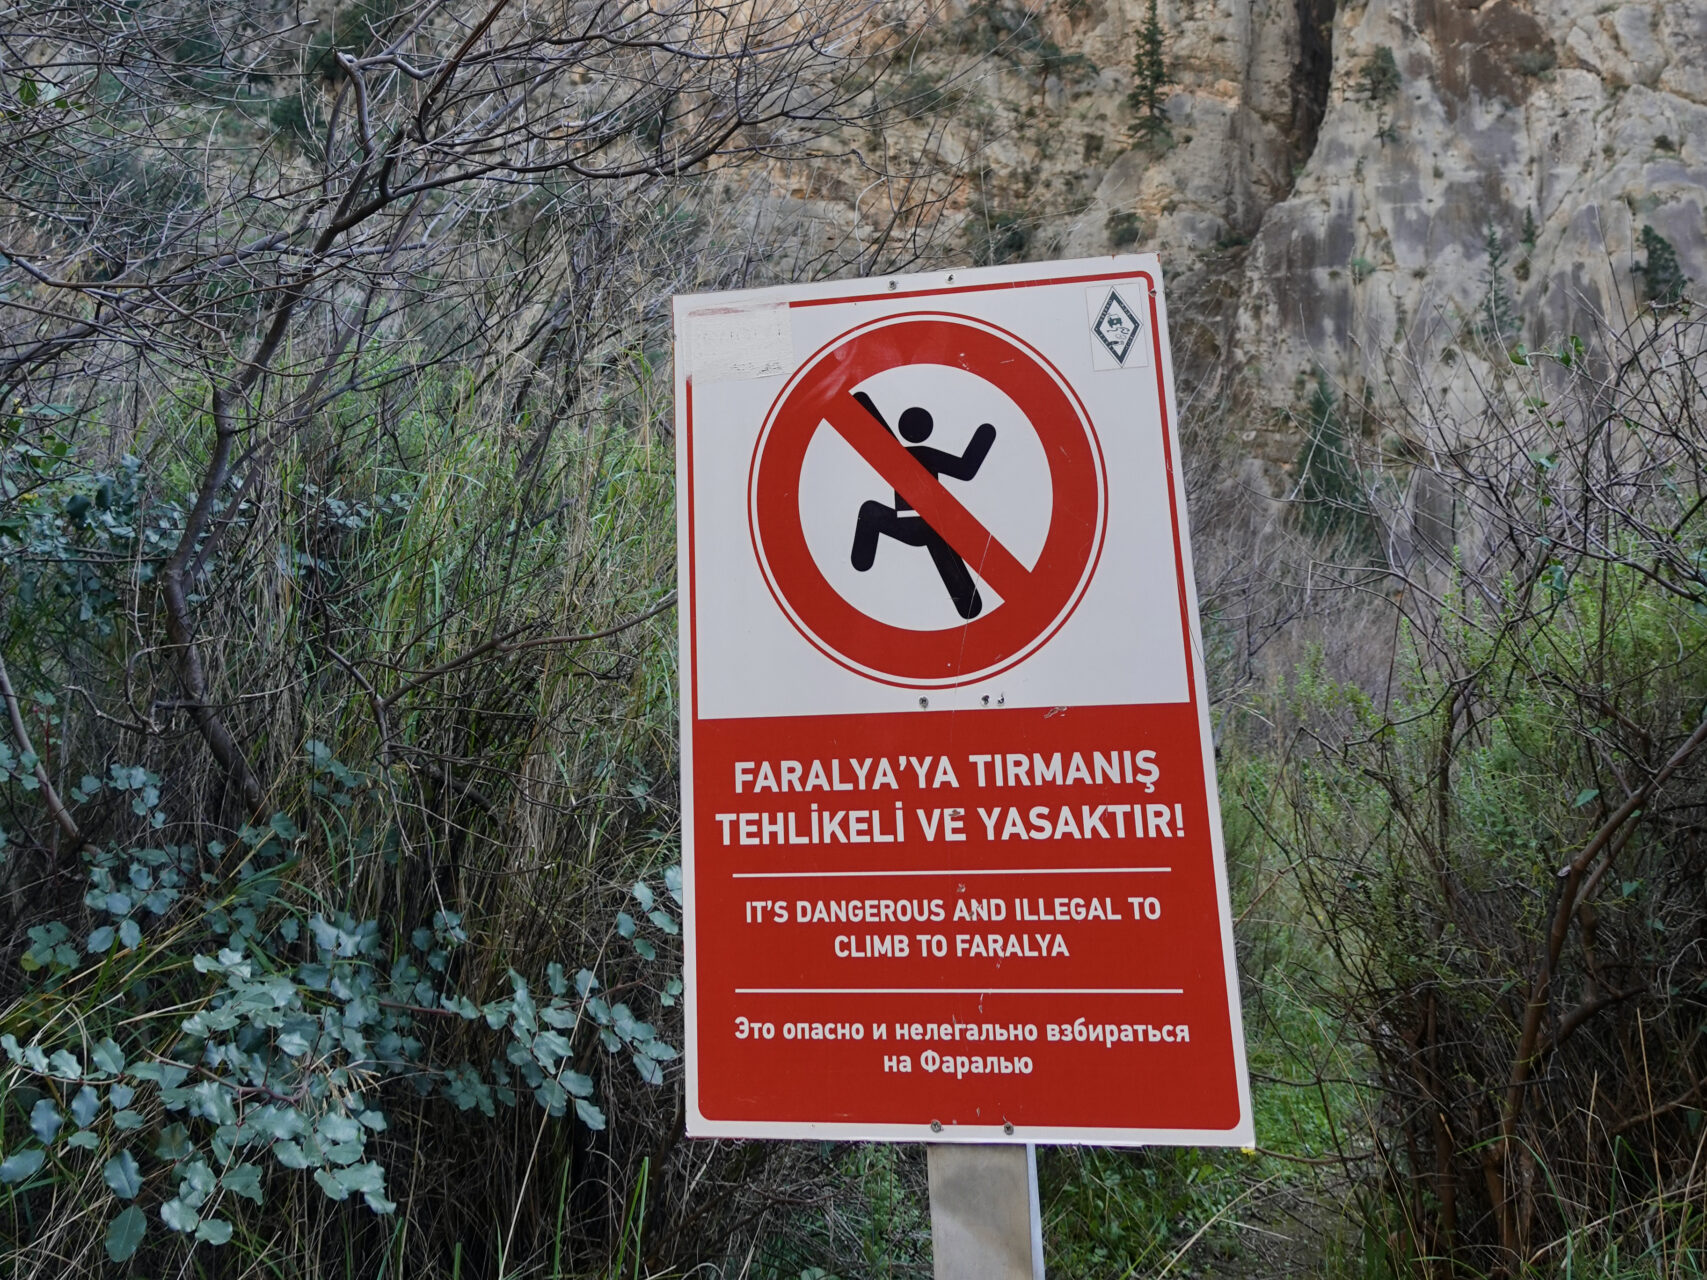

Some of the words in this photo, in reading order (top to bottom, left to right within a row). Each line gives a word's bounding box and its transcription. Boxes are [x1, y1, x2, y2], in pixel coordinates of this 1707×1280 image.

[735, 756, 959, 793] FARALYA'YA
[969, 750, 1159, 793] TIRMANIŞ
[715, 801, 904, 845] TEHLİKELİ
[916, 808, 966, 841] VE
[977, 804, 1184, 840] YASAKTIR!
[746, 900, 788, 923] IT'S
[797, 899, 945, 922] DANGEROUS
[953, 899, 1006, 921] AND
[1015, 898, 1122, 920] ILLEGAL
[1128, 897, 1161, 920] TO
[835, 935, 909, 957] CLIMB
[916, 935, 947, 957] TO
[956, 934, 1069, 958] FARALYA
[735, 1017, 775, 1039] Это
[783, 1023, 864, 1040] опасно
[873, 1023, 886, 1040] и
[896, 1022, 1037, 1041] нелегально
[1047, 1017, 1190, 1048] взбираться
[884, 1056, 911, 1072] на
[920, 1050, 1033, 1079] Фаралью
